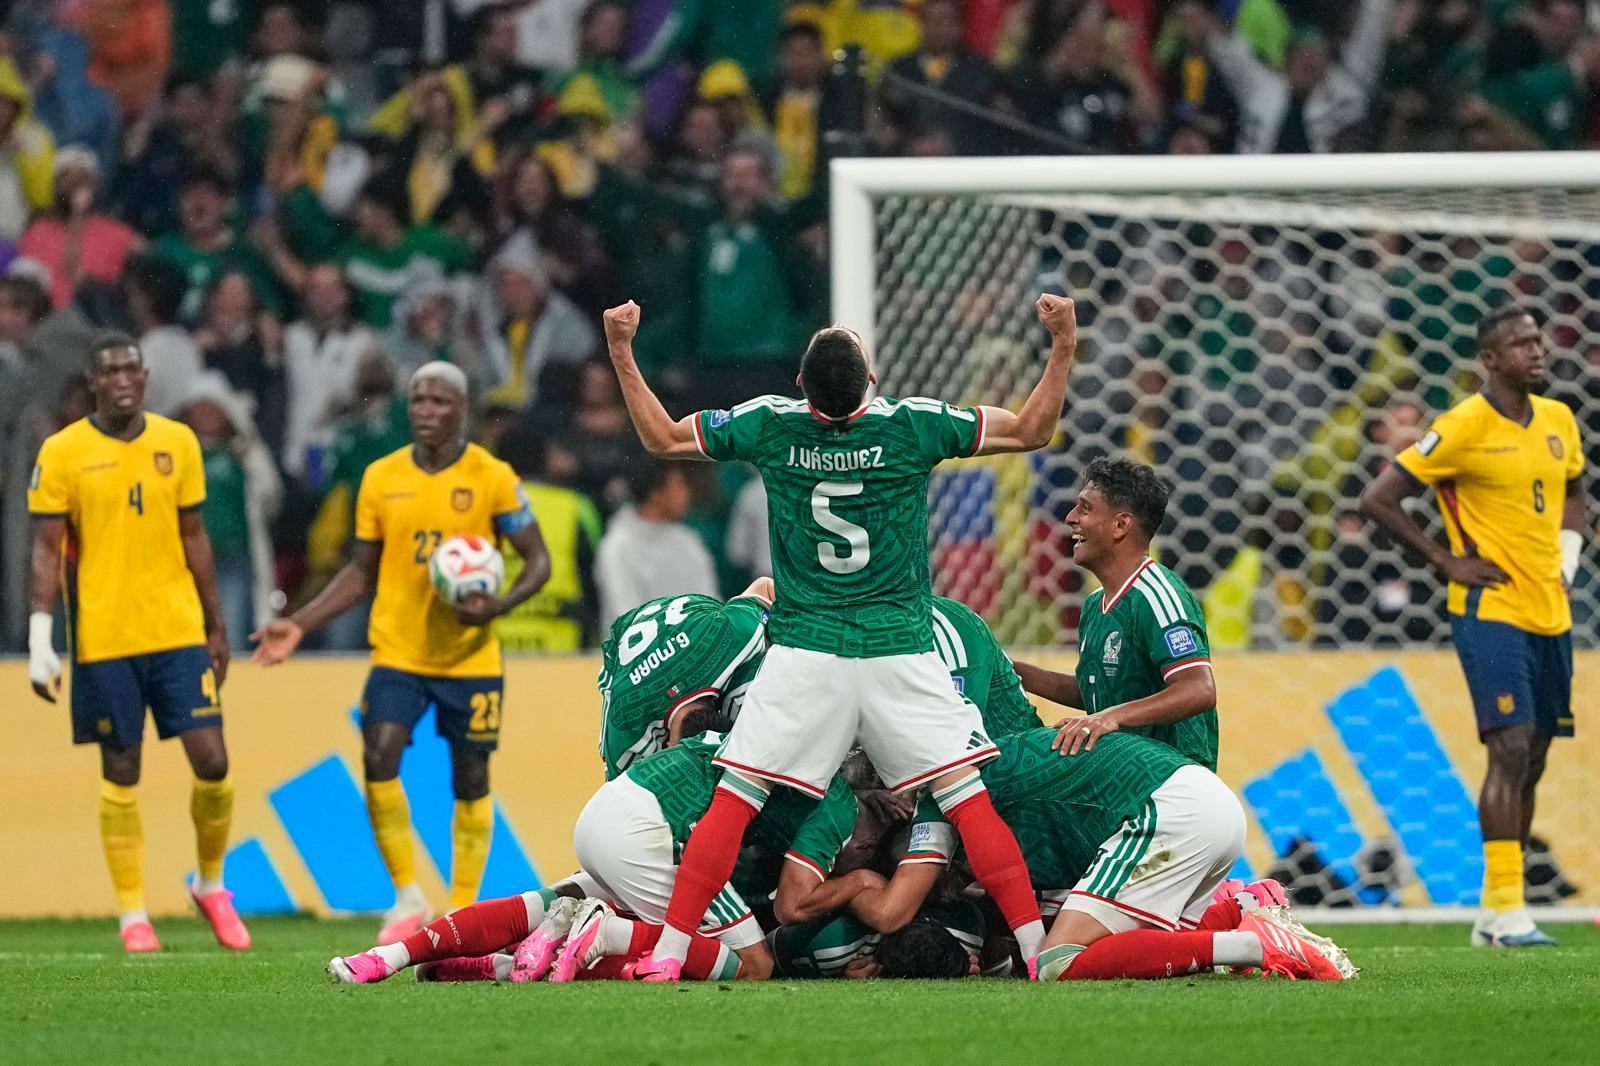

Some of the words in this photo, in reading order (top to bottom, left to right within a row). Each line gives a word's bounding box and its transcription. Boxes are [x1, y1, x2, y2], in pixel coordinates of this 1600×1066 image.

[786, 445, 886, 472] J.VÁSQUEZ
[128, 480, 144, 515] 4
[1532, 477, 1546, 513] 6
[811, 480, 870, 574] 5
[629, 631, 690, 686] G.MORA
[201, 667, 217, 705] 4
[469, 691, 500, 731] 23
